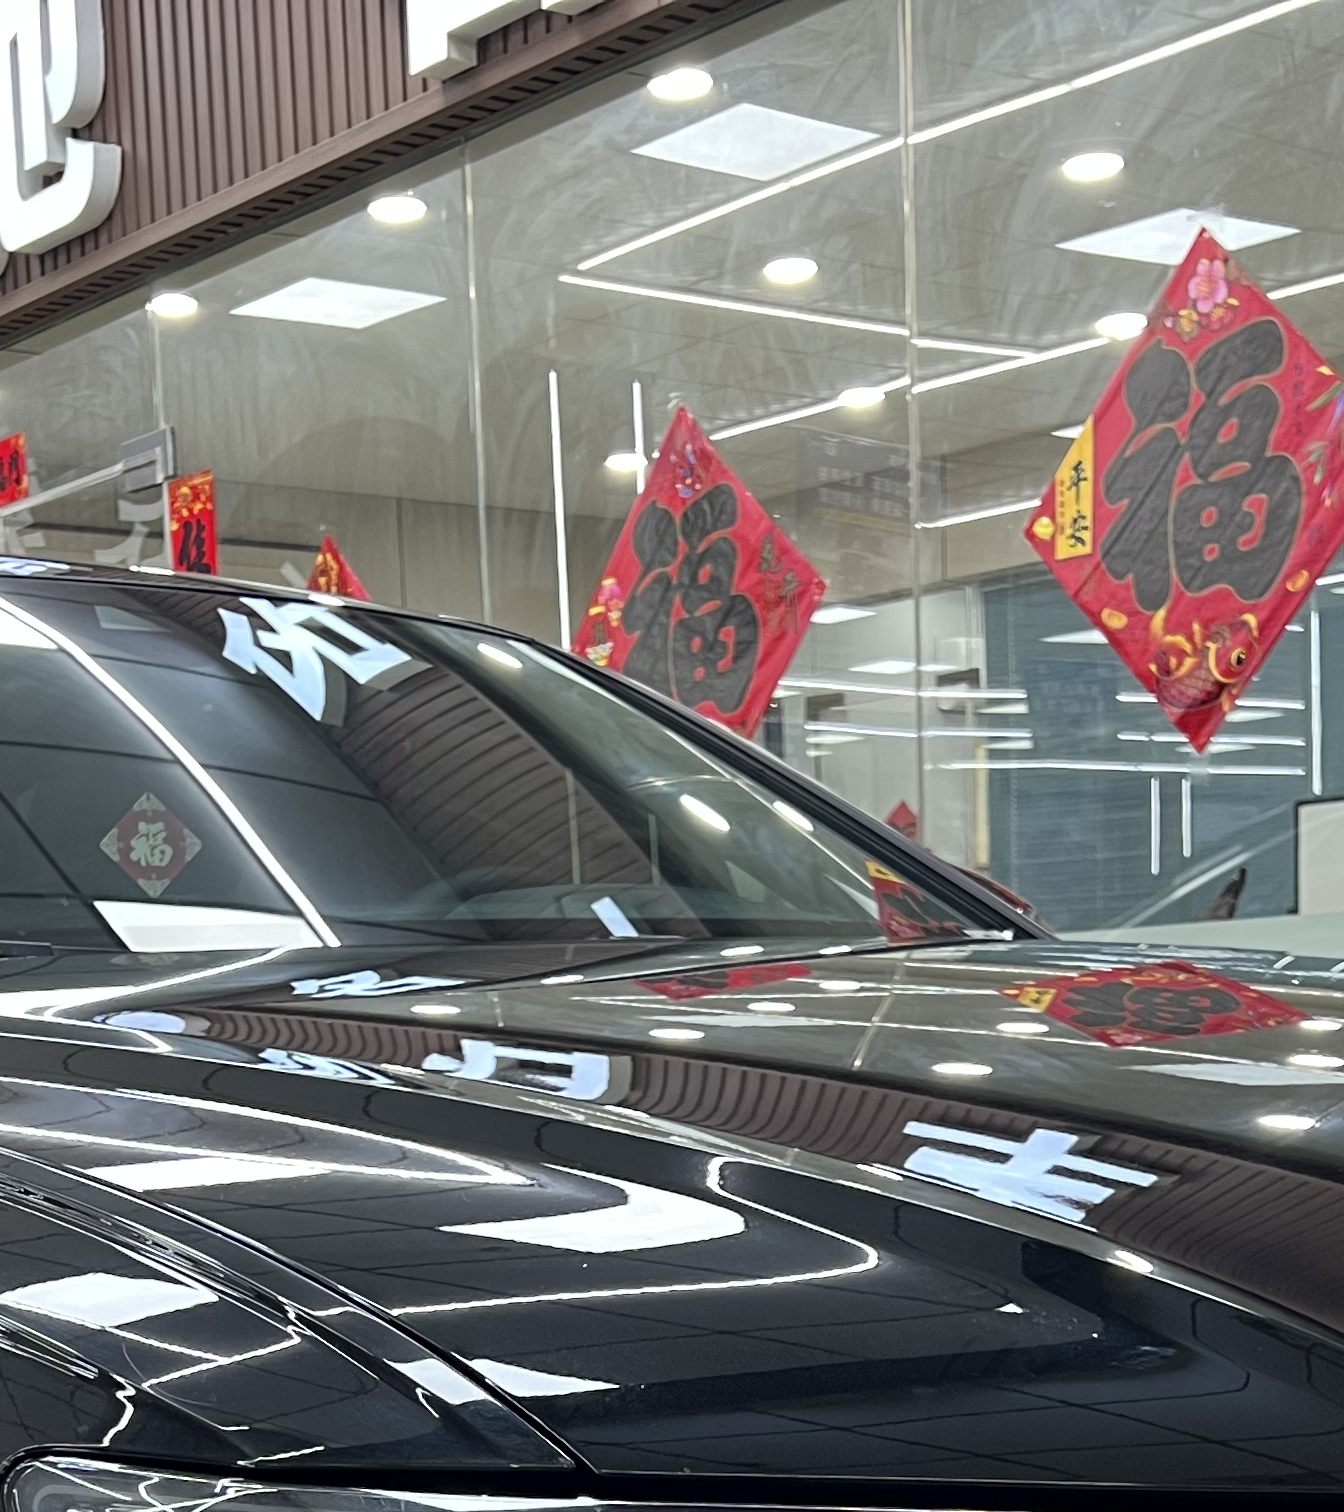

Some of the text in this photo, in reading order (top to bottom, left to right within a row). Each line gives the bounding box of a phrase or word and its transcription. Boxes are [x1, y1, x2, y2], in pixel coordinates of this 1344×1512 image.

[1067, 460, 1090, 548] 平安
[1098, 318, 1304, 614] 福
[622, 484, 760, 713] 福
[129, 821, 173, 867] 福
